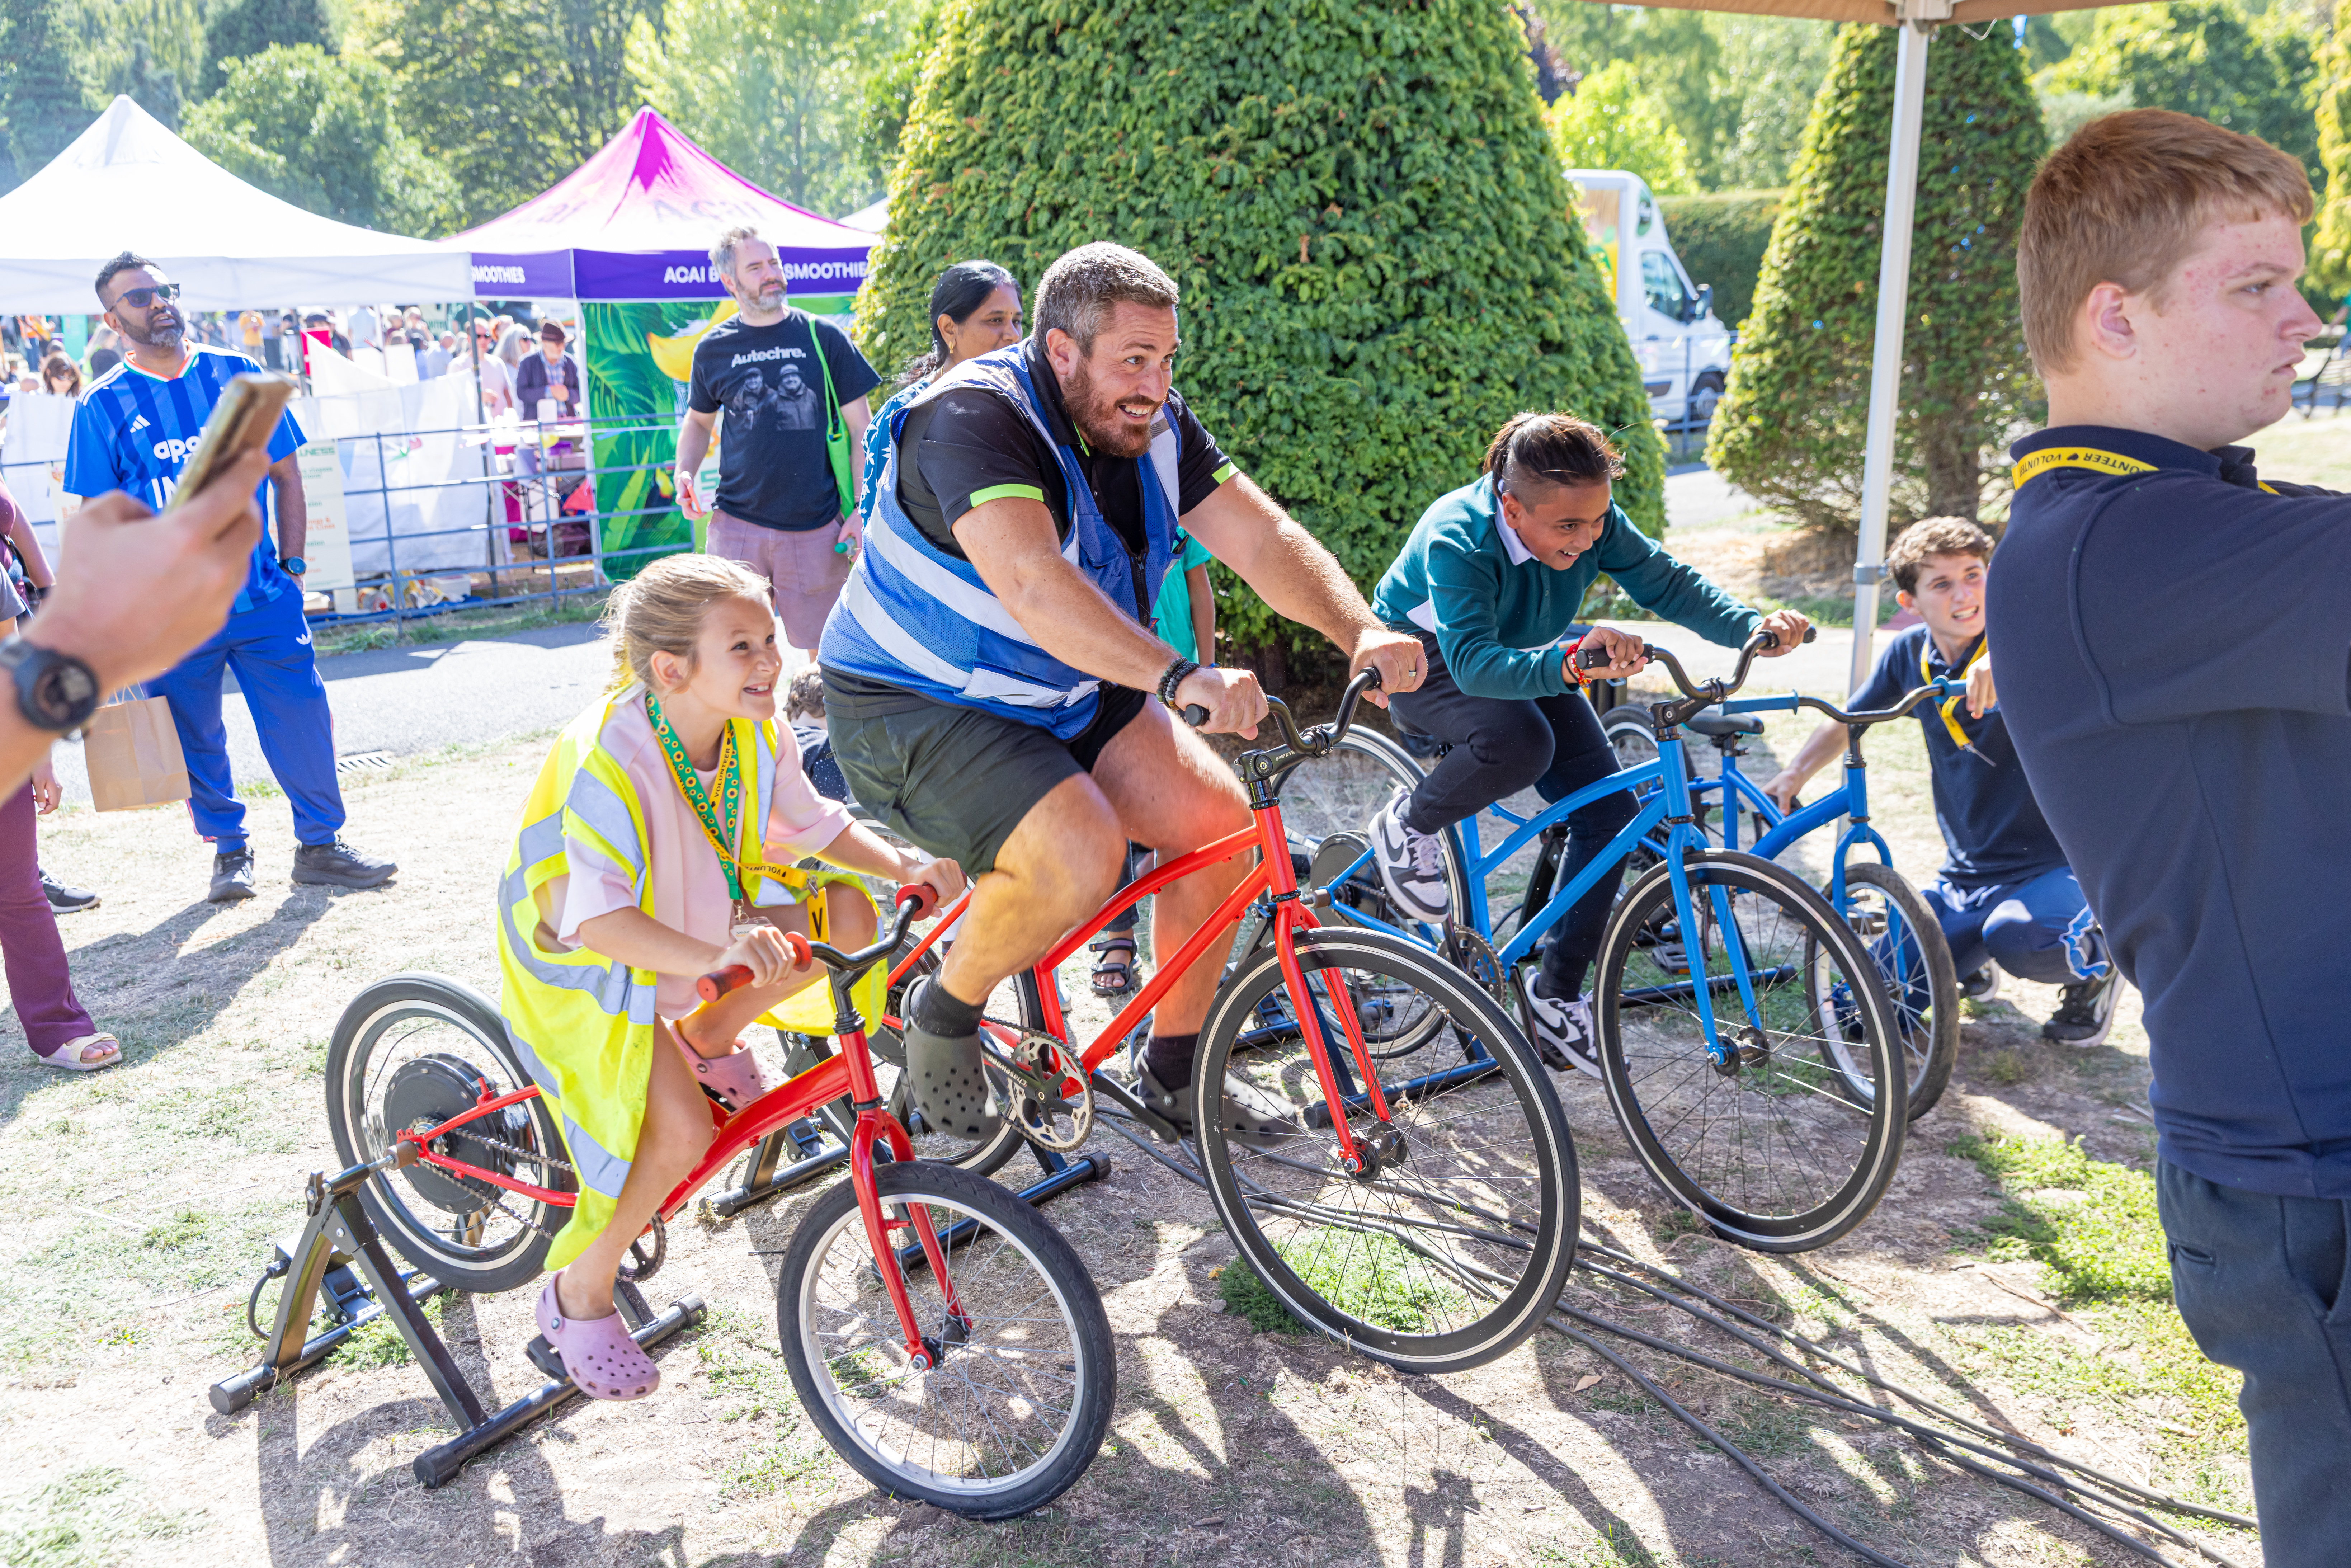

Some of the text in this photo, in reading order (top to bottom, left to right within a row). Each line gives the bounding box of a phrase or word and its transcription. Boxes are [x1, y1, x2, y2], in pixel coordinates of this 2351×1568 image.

[663, 265, 706, 283] ACAI
[783, 261, 868, 280] SMOOTHIE
[731, 346, 807, 368] Autechre.
[714, 748, 730, 797] VOLUNTEER
[812, 907, 823, 938] V
